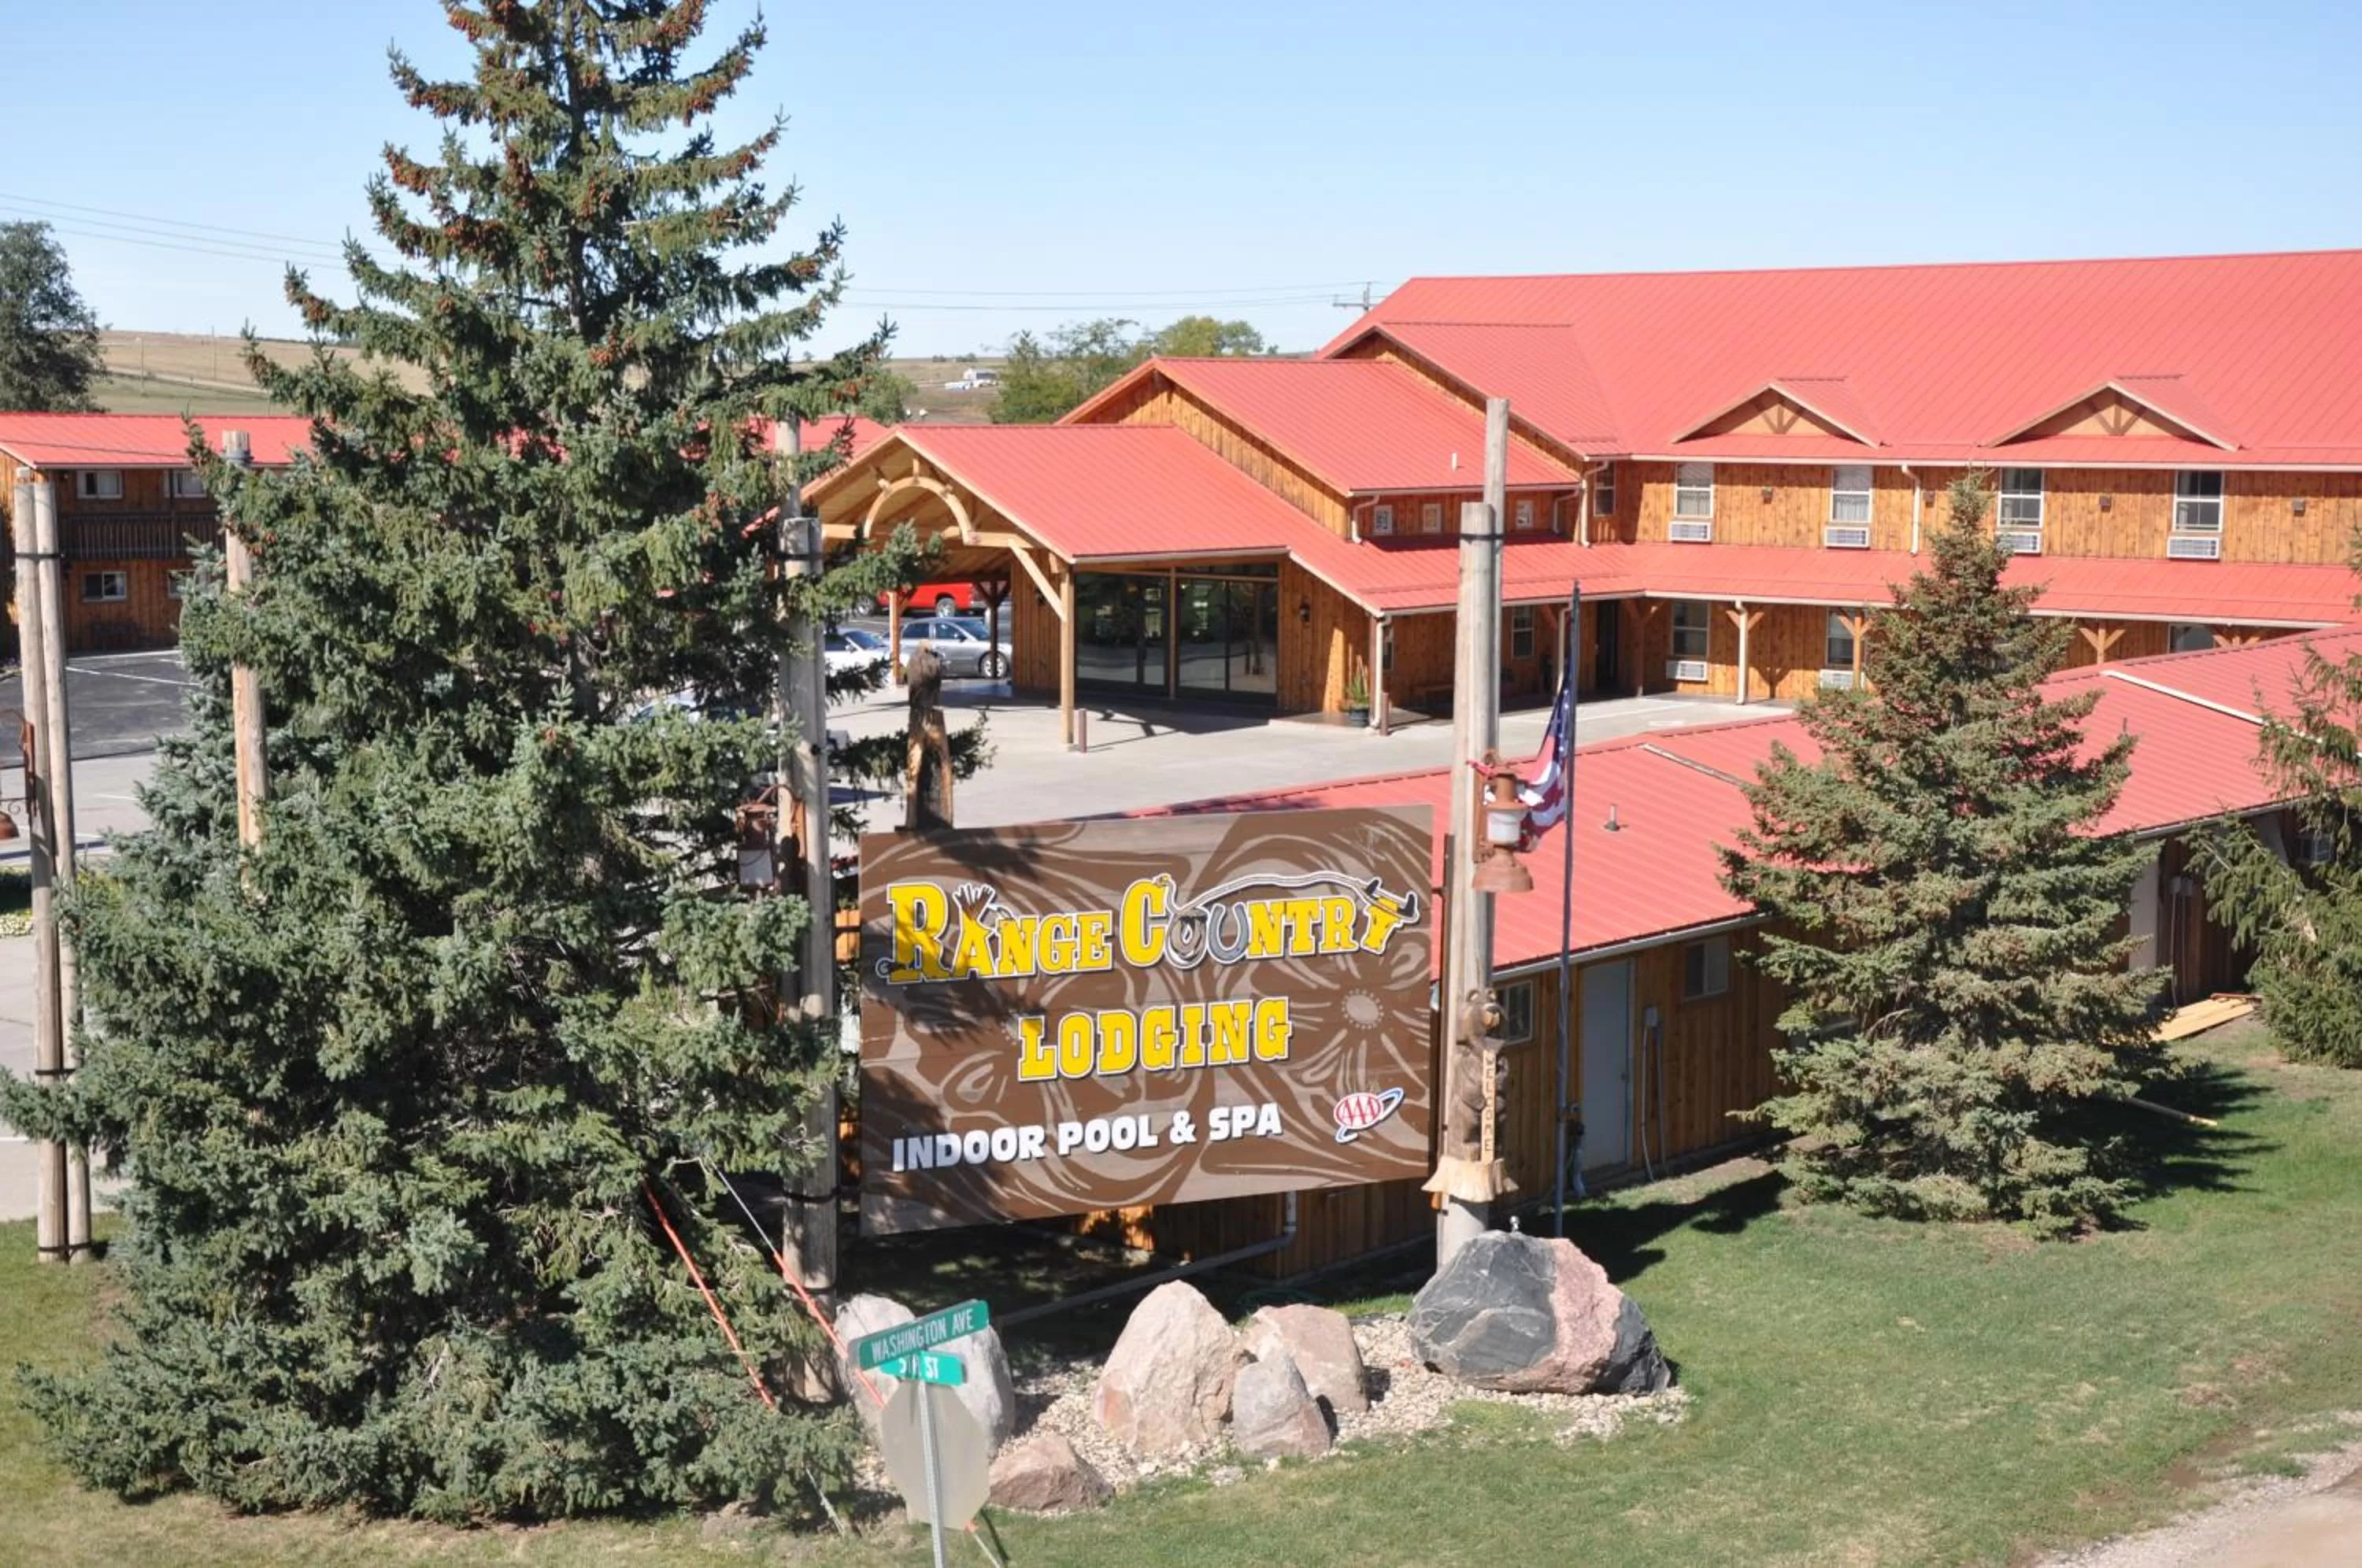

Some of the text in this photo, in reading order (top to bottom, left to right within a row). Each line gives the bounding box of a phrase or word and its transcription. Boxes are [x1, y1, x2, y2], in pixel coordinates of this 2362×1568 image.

[884, 872, 1420, 985] RANGE COUNTRY
[1017, 996, 1293, 1082] LODGING
[891, 1103, 1283, 1173] INDOOR POOL & SPA
[1337, 1094, 1380, 1128] AAA
[1483, 1055, 1495, 1152] WELCOME
[871, 1308, 975, 1363] WASHINGTON AVE
[924, 1355, 939, 1380] ST
